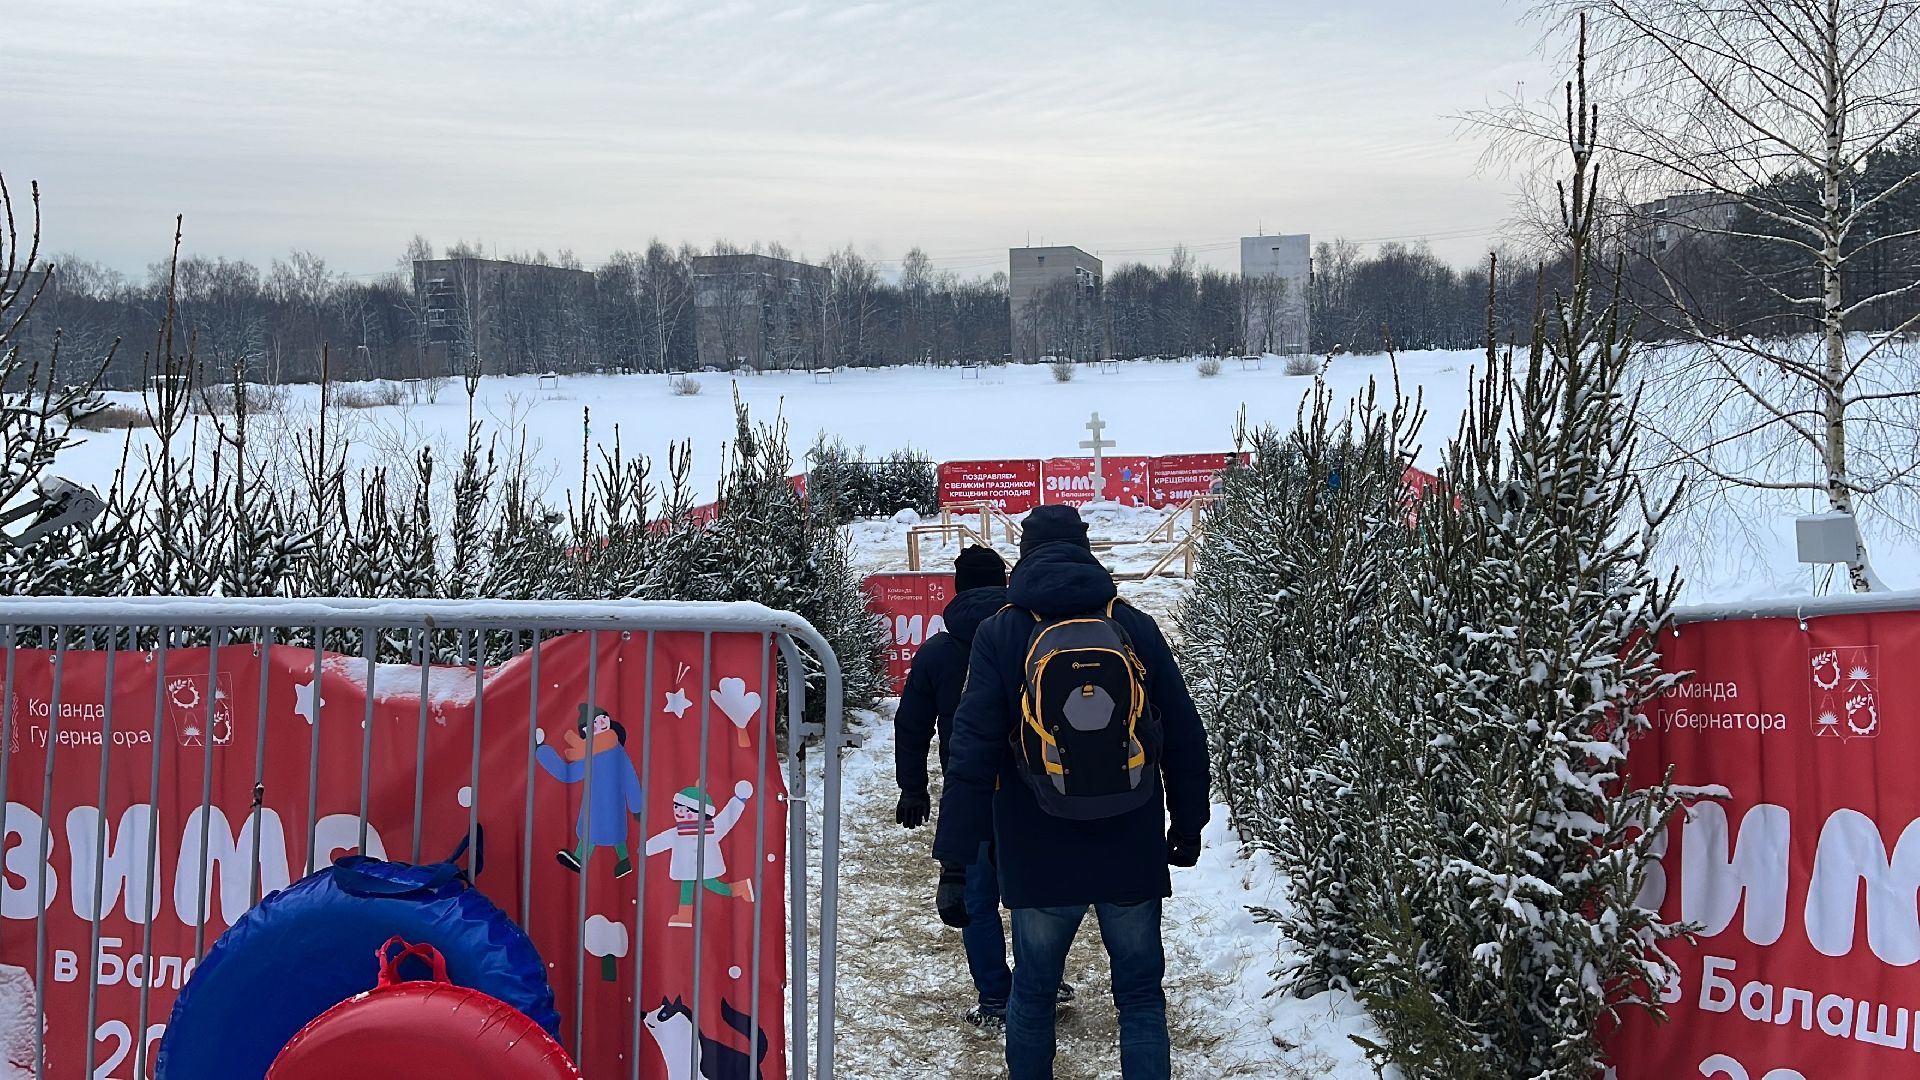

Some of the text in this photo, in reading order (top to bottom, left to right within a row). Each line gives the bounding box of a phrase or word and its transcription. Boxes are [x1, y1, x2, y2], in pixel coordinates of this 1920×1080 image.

[950, 481, 985, 489] ВЕЛИКИМ
[985, 481, 1036, 489] ПРАЗДНИКОМ
[962, 473, 1017, 481] ПОЗДРАВЛЯЕМ
[1046, 475, 1106, 491] ЗИМ
[1154, 475, 1198, 485] КРЕЩЕНИЯ
[949, 489, 1031, 498] КРЕЩЕНИЯ ГОСПОДНЯ!
[1657, 708, 1787, 734] Губернатора
[30, 725, 152, 749] Гуернаора
[54, 949, 79, 983] в
[1699, 955, 1920, 1051] Балаш
